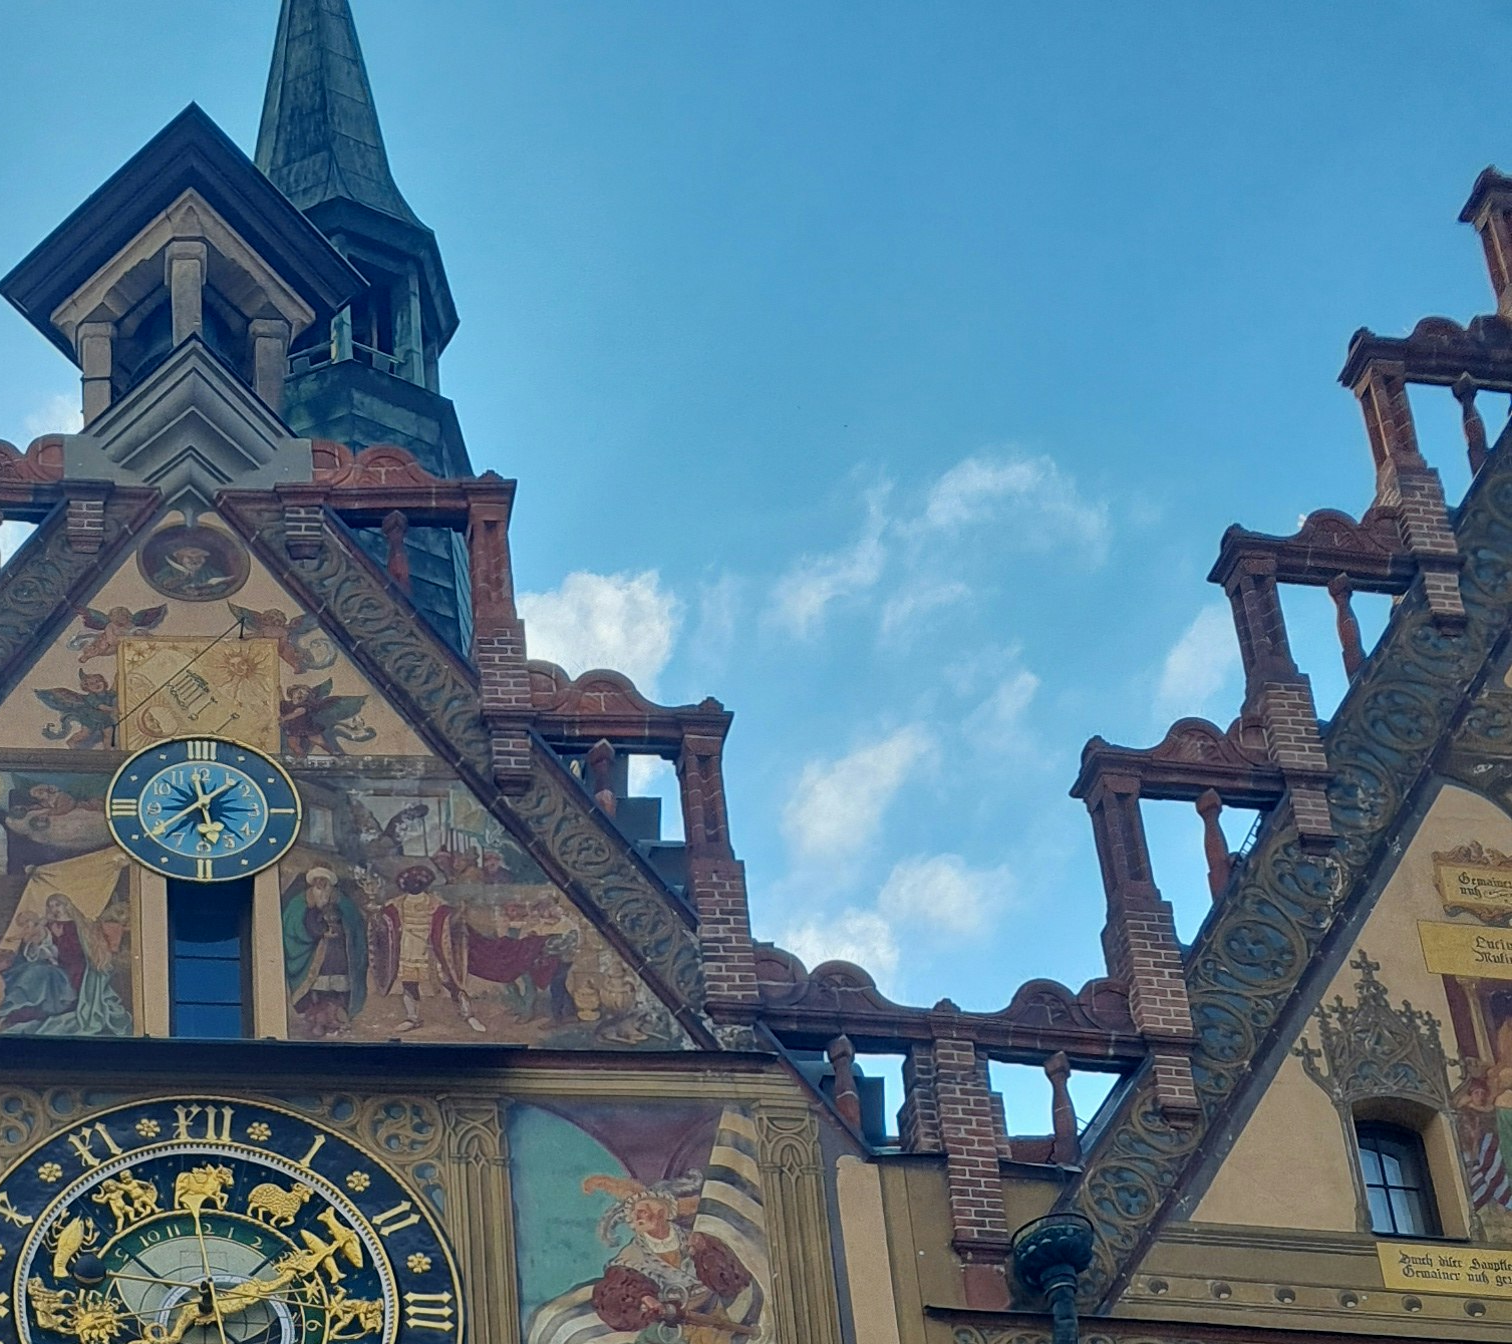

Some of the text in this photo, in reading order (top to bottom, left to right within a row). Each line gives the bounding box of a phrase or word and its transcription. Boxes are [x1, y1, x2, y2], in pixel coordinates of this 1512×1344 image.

[187, 740, 217, 761] IIII
[153, 782, 171, 796] 10
[171, 770, 185, 786] 11
[241, 783, 254, 797] 2
[112, 798, 137, 817] III
[197, 858, 214, 880] II
[173, 1103, 236, 1143] XII
[68, 1121, 123, 1167] XI
[299, 1134, 326, 1168] I
[371, 1200, 422, 1237] II
[403, 1290, 455, 1332] III
